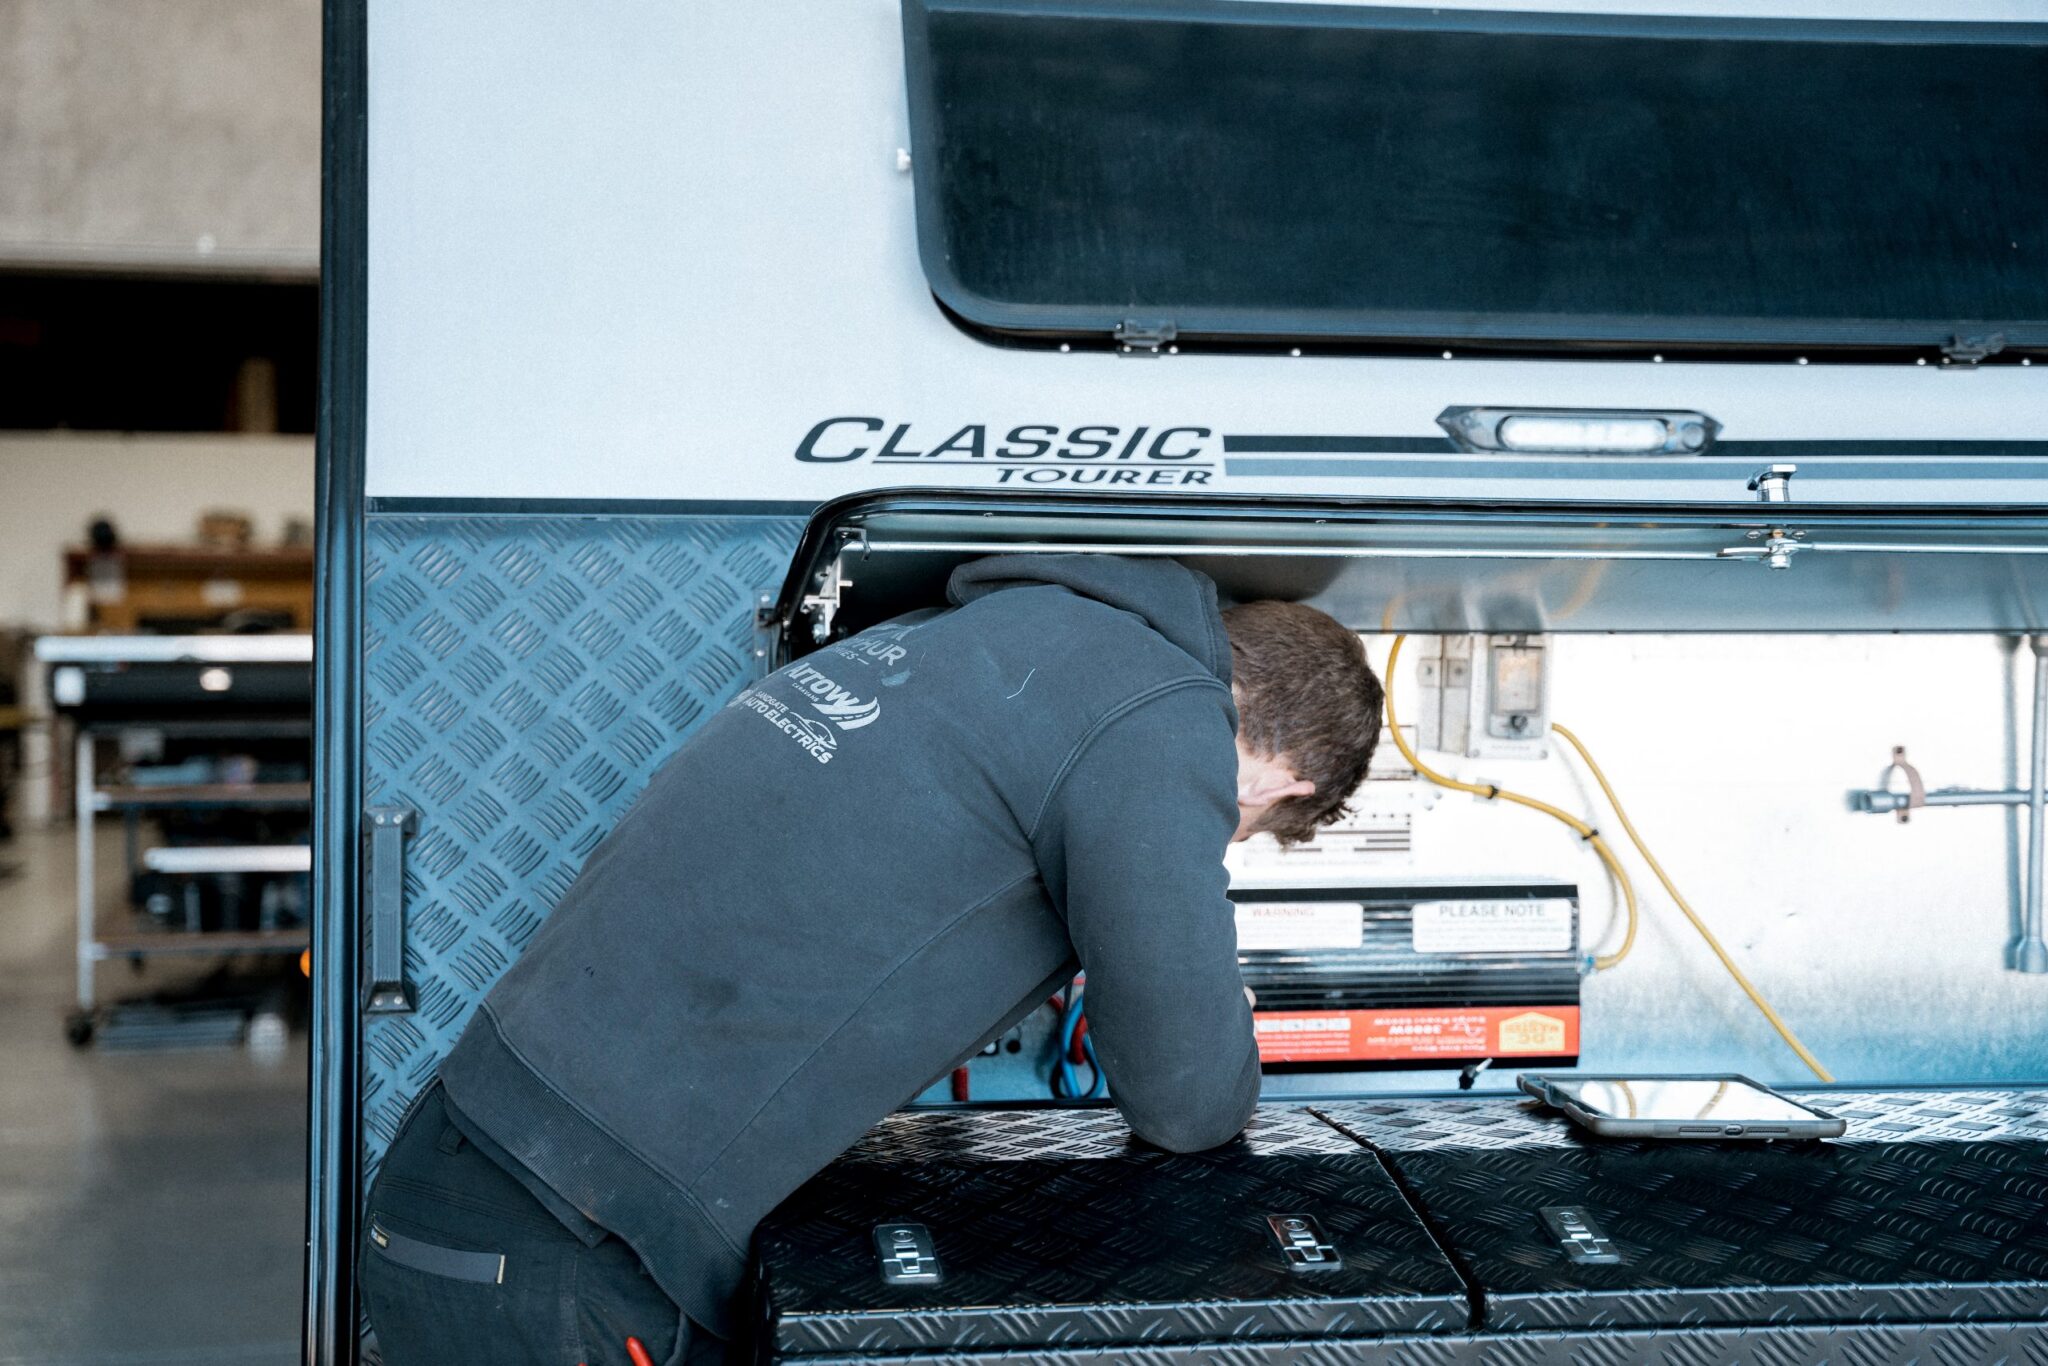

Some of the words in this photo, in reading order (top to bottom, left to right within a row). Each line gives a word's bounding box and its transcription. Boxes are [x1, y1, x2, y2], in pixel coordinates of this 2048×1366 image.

[795, 417, 1211, 463] CLASSIC
[997, 468, 1214, 485] TOURER
[845, 637, 907, 667] HUR
[756, 691, 789, 713] SANDGATE
[792, 682, 820, 702] CARAVANS
[743, 696, 769, 713] AUTO
[764, 709, 834, 764] ELECTRICS
[1439, 904, 1499, 917] PLEASE
[1504, 904, 1546, 917] NOTE
